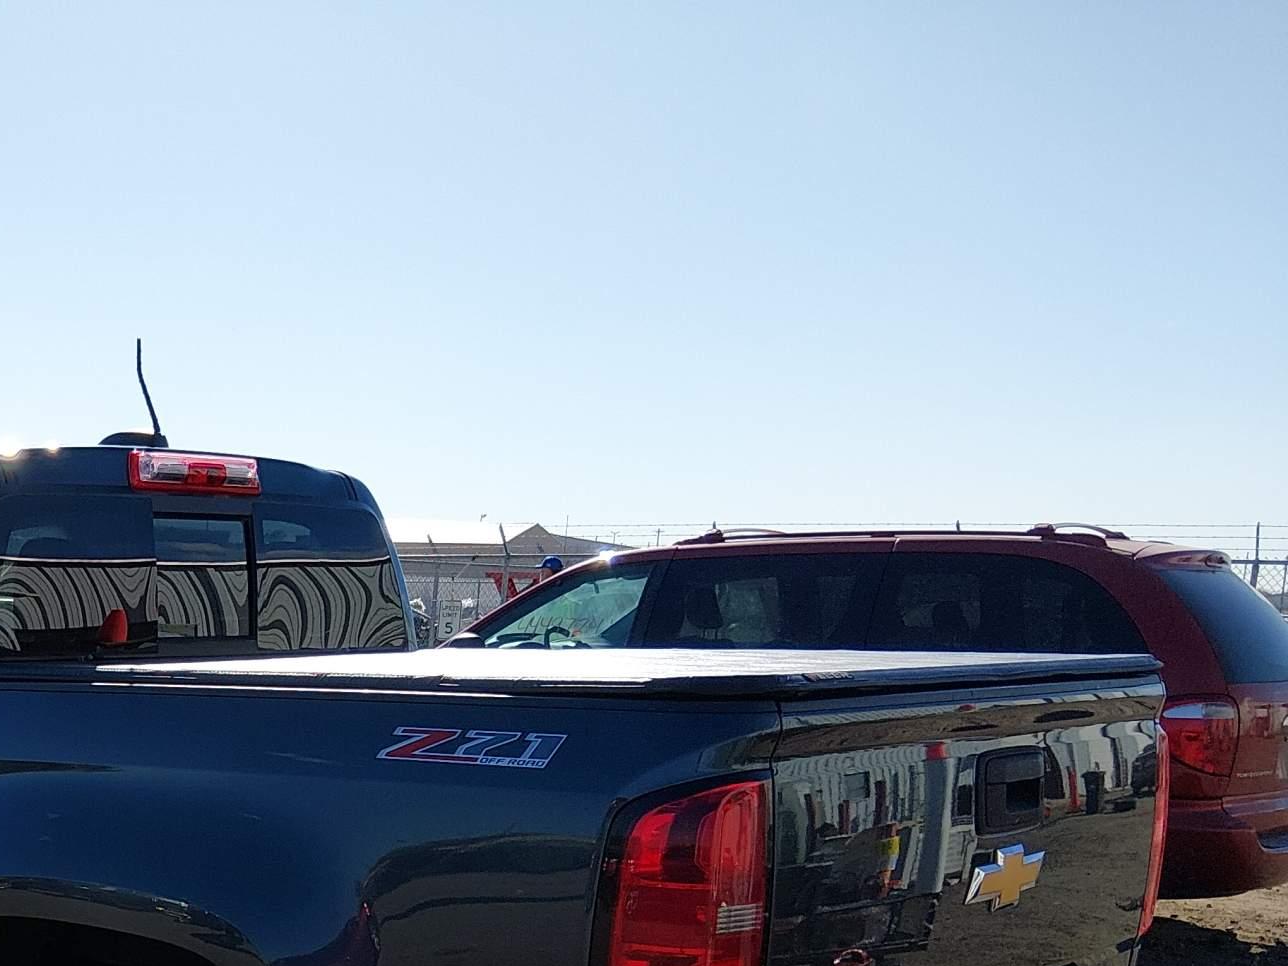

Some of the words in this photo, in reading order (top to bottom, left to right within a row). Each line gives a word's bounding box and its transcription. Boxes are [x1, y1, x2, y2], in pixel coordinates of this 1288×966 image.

[444, 622, 453, 634] 5
[376, 727, 568, 765] Z71
[507, 758, 547, 768] ROAD
